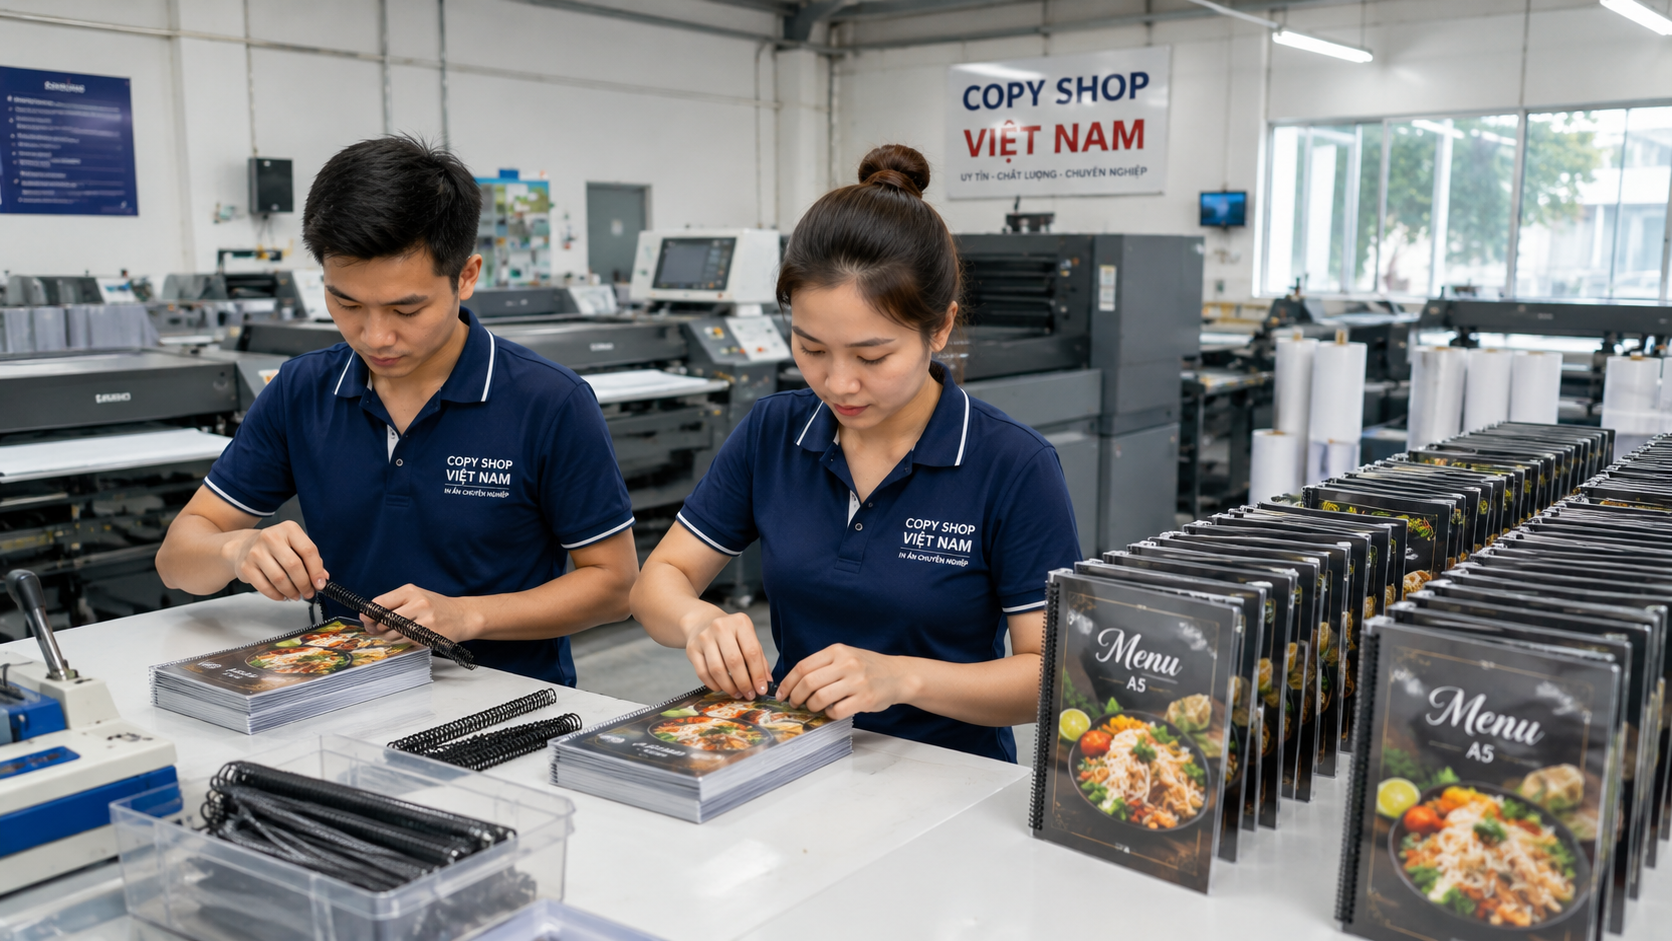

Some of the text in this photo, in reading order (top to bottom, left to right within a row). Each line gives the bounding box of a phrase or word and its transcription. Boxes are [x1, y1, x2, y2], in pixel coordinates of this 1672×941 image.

[963, 71, 1150, 111] COPY SHOP
[963, 118, 1145, 164] VIỆT NAM
[960, 172, 973, 182] UY
[446, 455, 513, 470] COPY SHOP
[446, 468, 511, 486] VIỆT NAM
[905, 517, 976, 536] COPY SHOP
[903, 531, 973, 553] VIỆT NAM
[898, 551, 907, 559] IN
[1095, 627, 1183, 677] Menu
[1126, 675, 1146, 693] A5
[1425, 685, 1546, 746] Menu
[1465, 741, 1495, 764] A5
